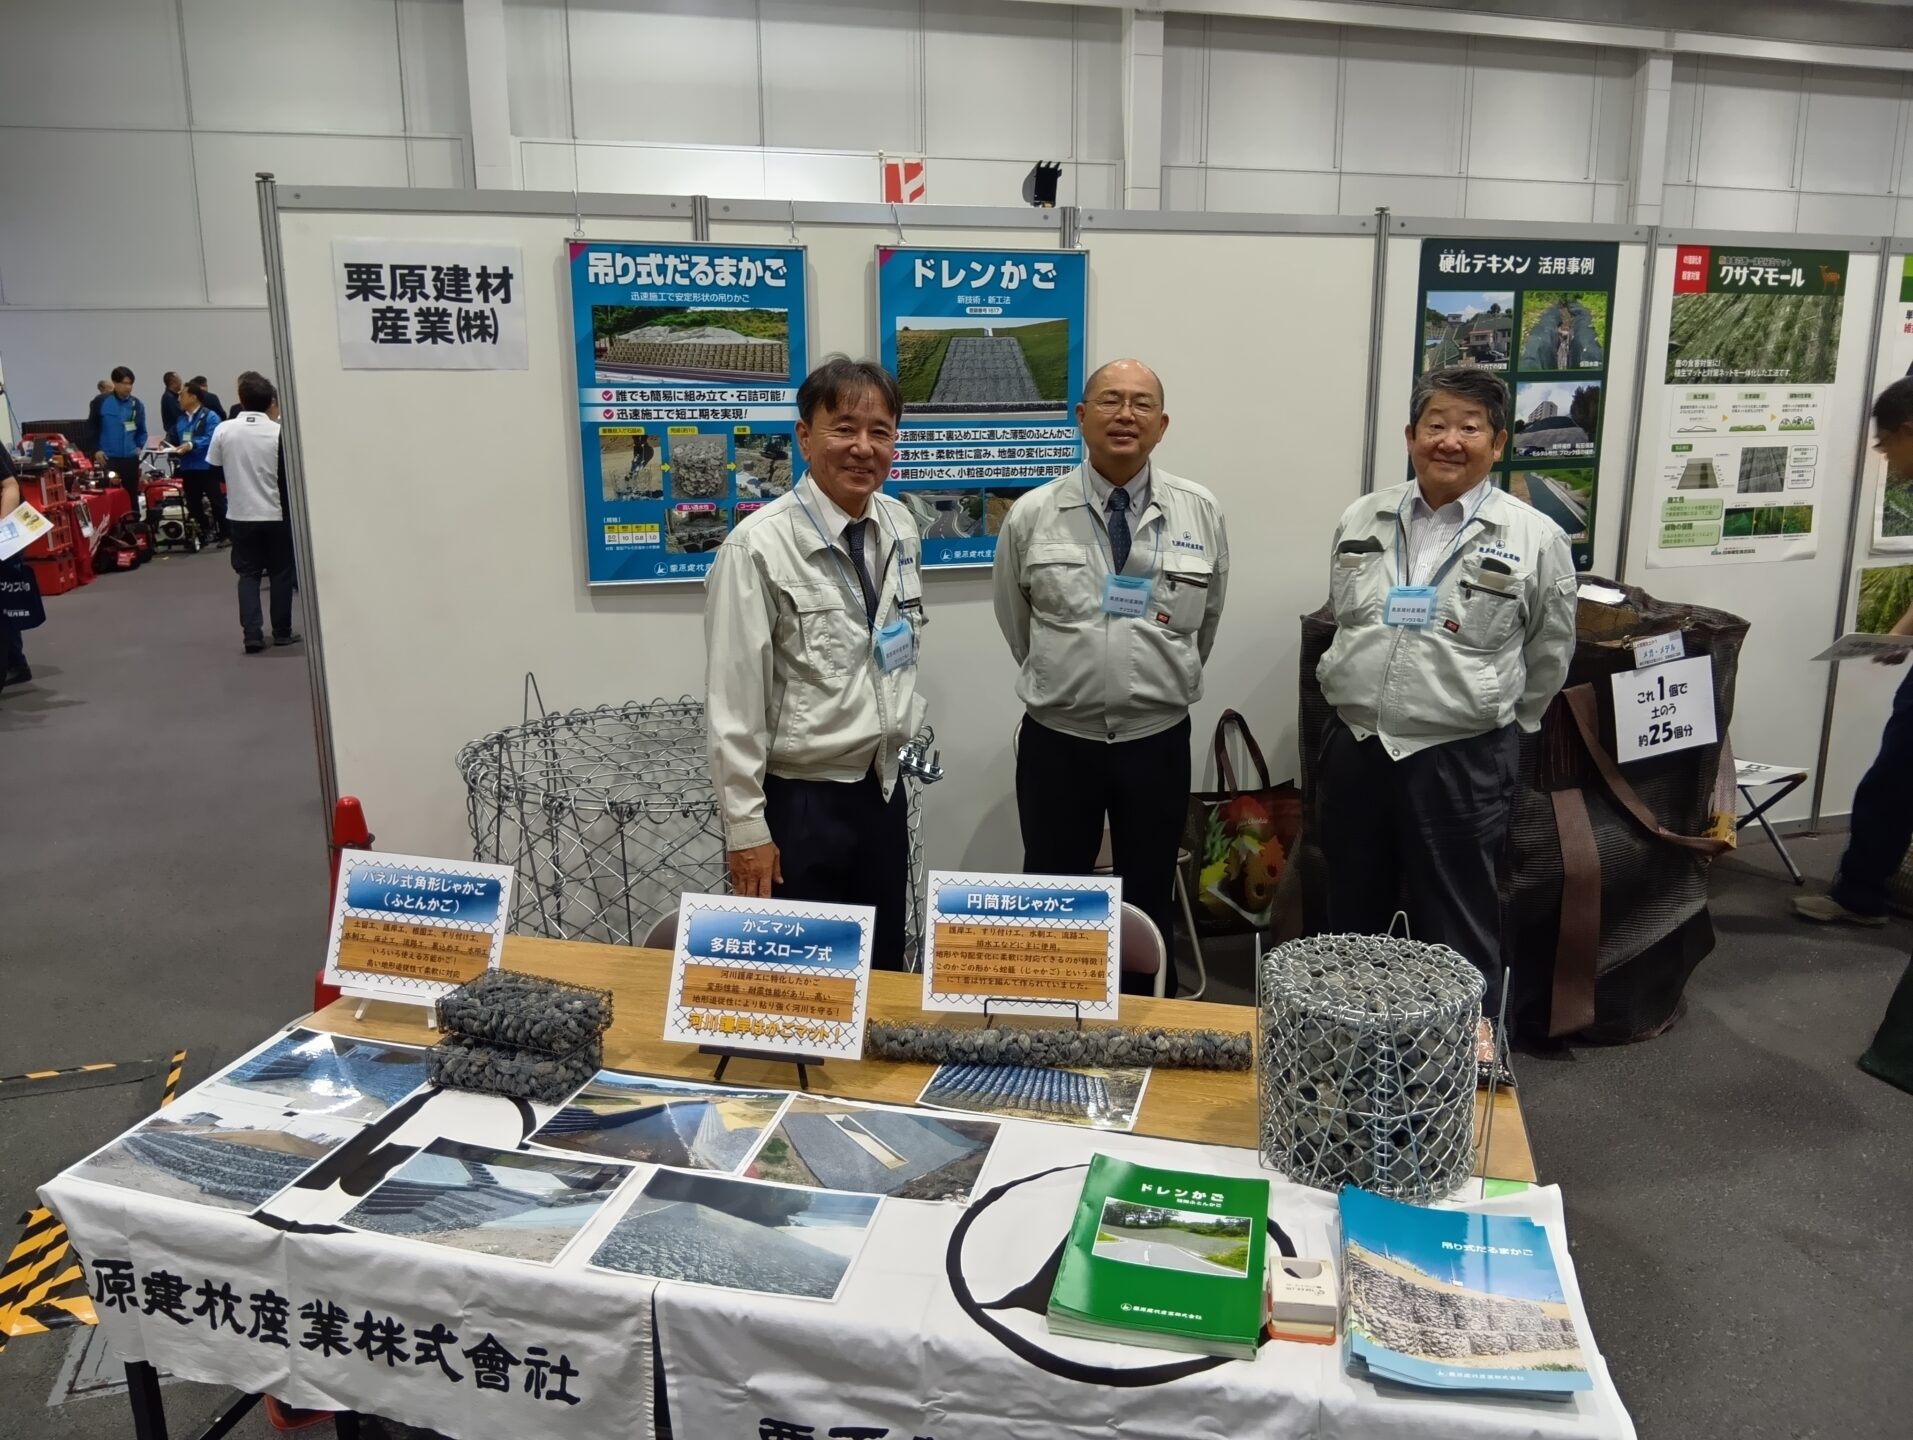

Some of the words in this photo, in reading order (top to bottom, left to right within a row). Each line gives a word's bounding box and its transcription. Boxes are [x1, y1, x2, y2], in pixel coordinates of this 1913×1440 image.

[588, 252, 787, 287] 吊り式だるまかご
[914, 258, 1057, 290] ドレンかご
[1439, 254, 1531, 274] 硬化テキメン
[1538, 257, 1595, 275] 活用事例
[344, 263, 514, 304] 栗原建材
[1720, 266, 1805, 287] クサマモール
[631, 291, 751, 304] 迅速施工で安定形状の吊りかご
[957, 295, 1011, 305] 新技術・新工法
[615, 389, 786, 403] 誰でも簡易に組み立て・石詰可能!
[616, 408, 748, 421] 迅速施工で短工期を実現!
[901, 447, 1075, 461] 透水性・柔軟性に富み、地盤の変化に対応!
[901, 466, 1075, 480] 網目が小さく、小粒径の中詰め材が使用可能!
[954, 550, 996, 559] 栗原建材産
[1637, 676, 1688, 704] これ1個で
[1651, 703, 1677, 719] 土のう
[1638, 721, 1693, 747] 約25個分
[967, 893, 1075, 912] 円筒形じゃかご
[742, 919, 805, 938] かごマット
[710, 937, 833, 962] 多段式・スロープ式
[720, 970, 821, 986] 河川護岸工に特化したかご
[687, 1012, 841, 1045] 河川護岸はかごマット！
[1141, 1183, 1225, 1202] ドレンかご
[1441, 1241, 1534, 1257] 吊り式だるまかご
[78, 1254, 582, 1407] 原建材産業株式會社
